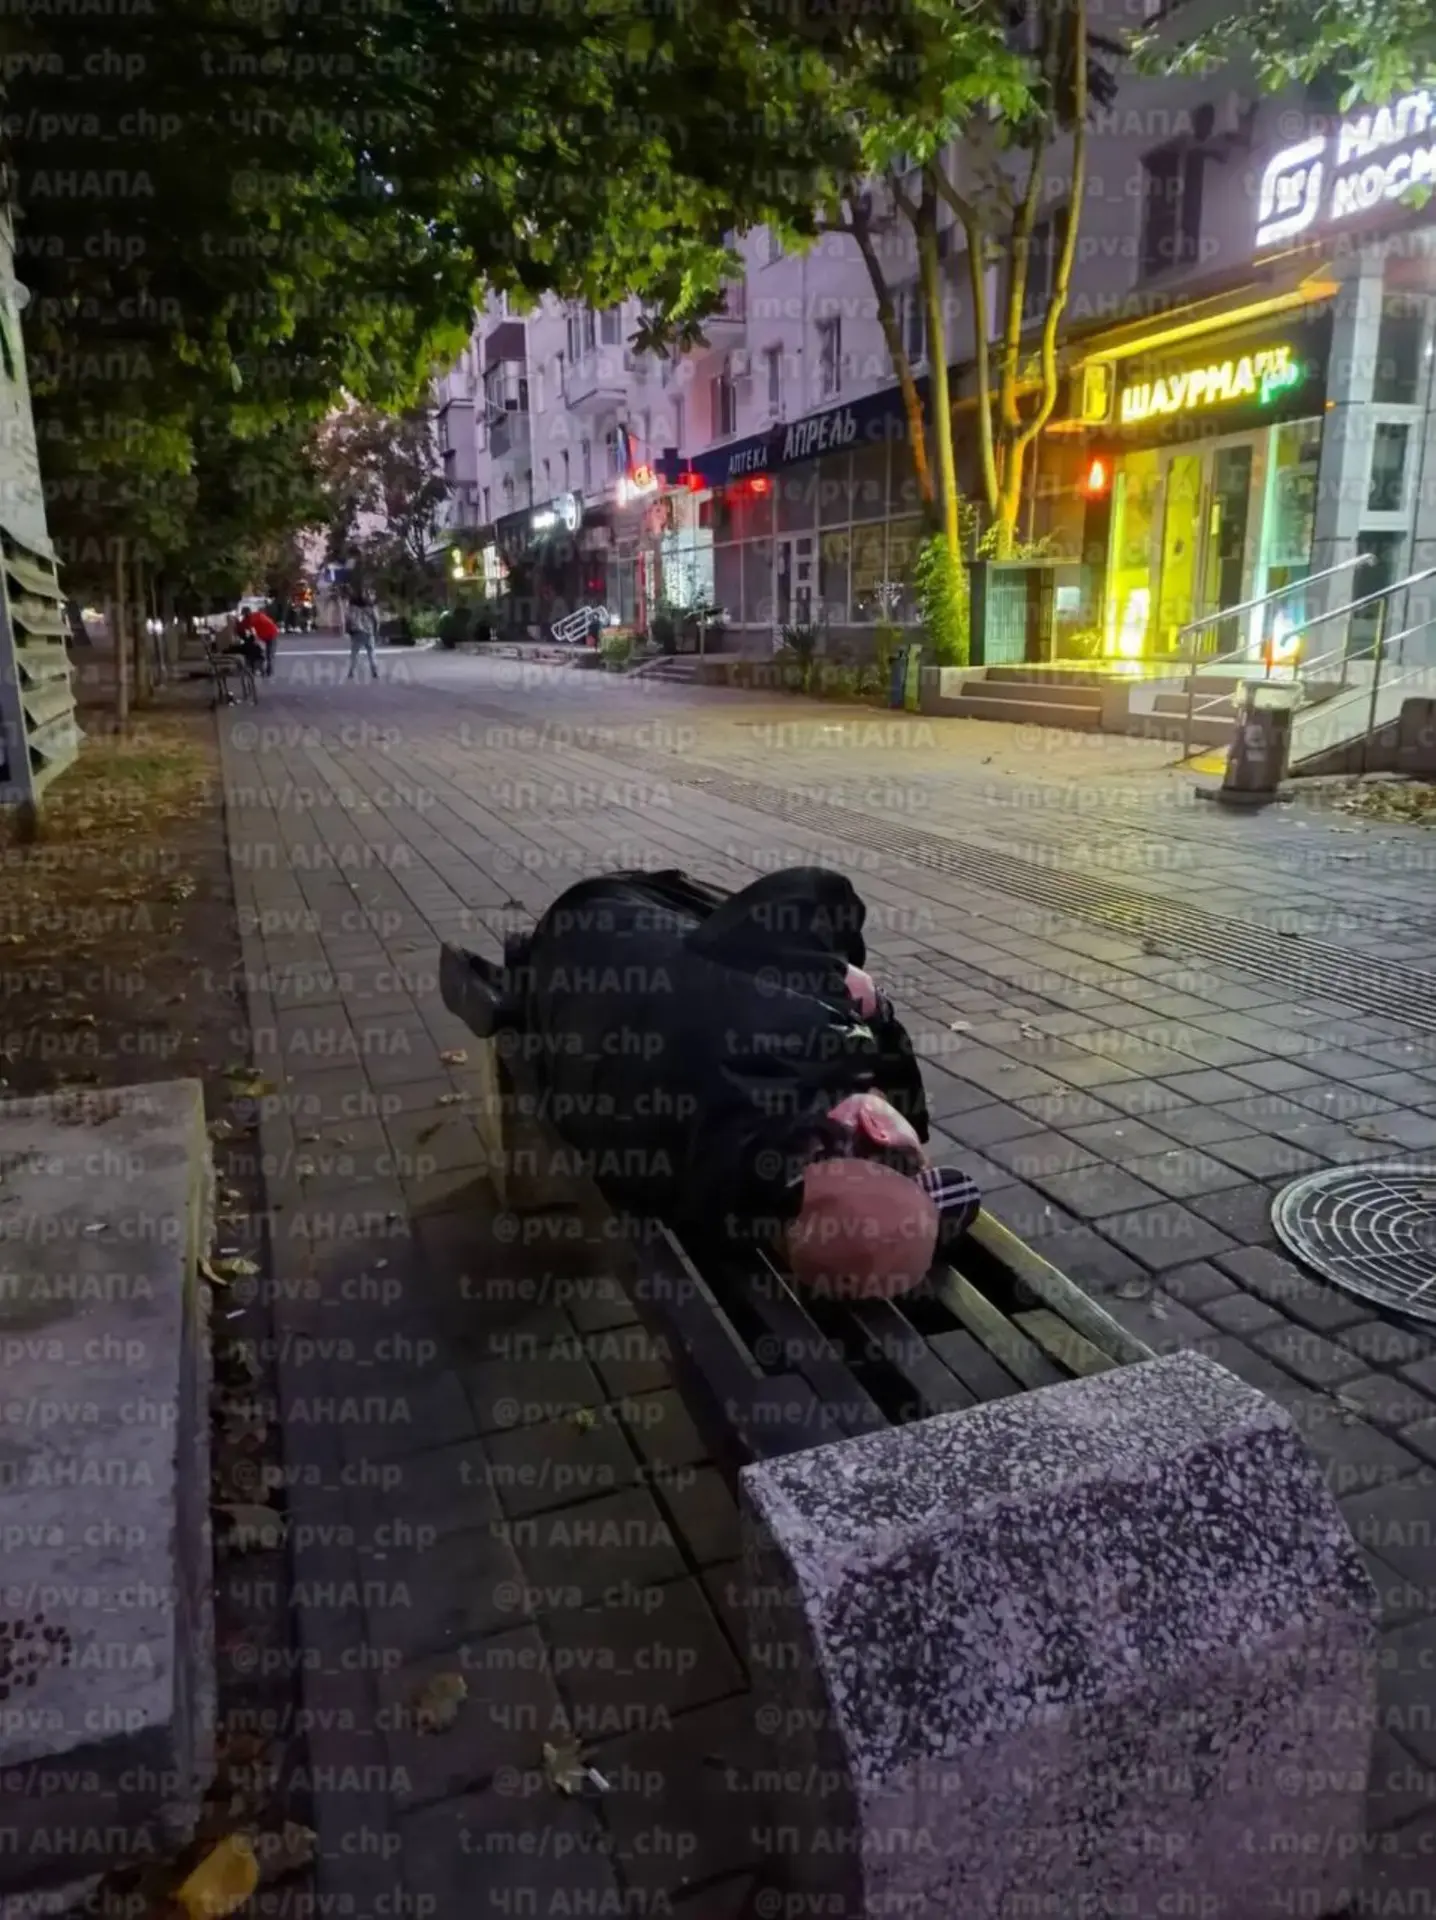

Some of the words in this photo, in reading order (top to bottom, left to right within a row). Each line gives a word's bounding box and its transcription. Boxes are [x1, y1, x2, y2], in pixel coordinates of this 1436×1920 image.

[1121, 355, 1256, 423] ШАУРМА
[729, 446, 768, 475] АПТЕКА
[782, 408, 857, 461] АПРЕЛЬ
